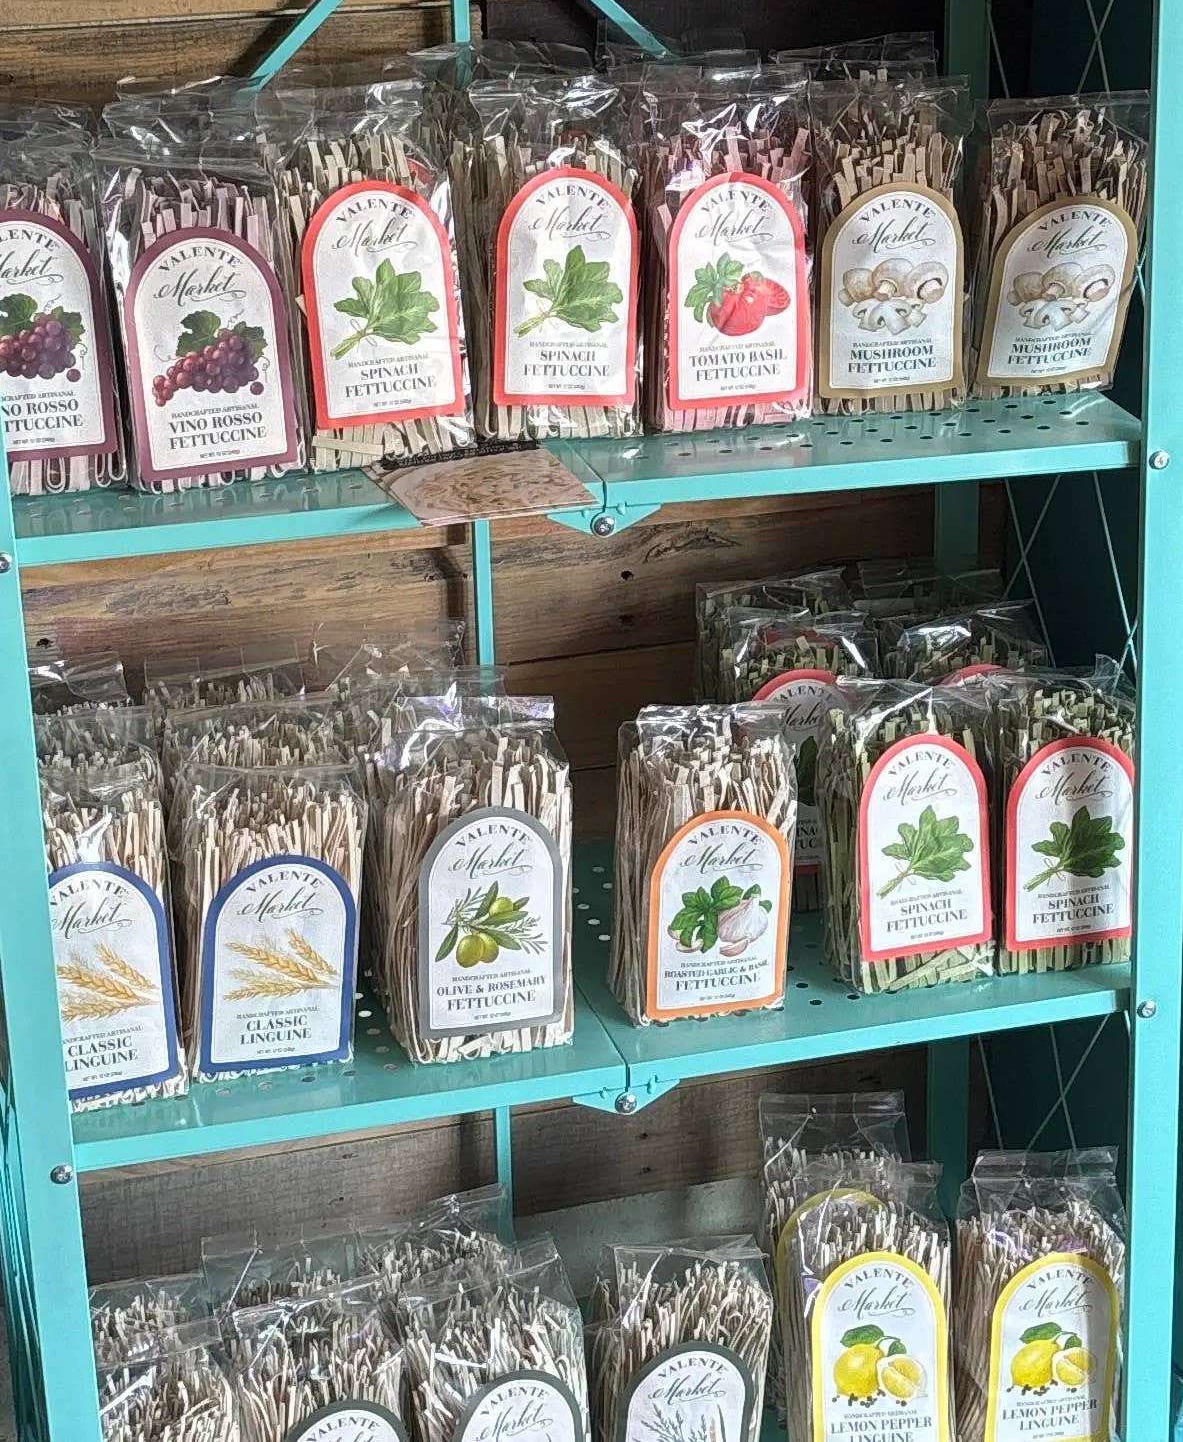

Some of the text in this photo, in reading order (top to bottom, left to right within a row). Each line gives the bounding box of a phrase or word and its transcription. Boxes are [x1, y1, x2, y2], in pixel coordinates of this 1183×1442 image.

[536, 185, 609, 208] VALENTE
[701, 190, 770, 213] VALENTE
[336, 198, 408, 224] VALENTE
[859, 198, 932, 222] VALENTE
[1038, 210, 1109, 231] VALENTE
[528, 205, 611, 241] Market
[695, 209, 774, 245] Market
[0, 229, 59, 251] LENTE
[331, 217, 418, 257] Market
[852, 216, 935, 253] Market
[1027, 225, 1107, 259] Market
[158, 246, 240, 272] VALENTE
[153, 266, 246, 307] Market
[540, 350, 596, 361] SPINACH
[850, 345, 934, 360] MUSHROOM
[1007, 347, 1091, 365] FETTUCCINE
[1011, 337, 1091, 354] MUSHROOM
[689, 348, 787, 367] TOMATO BASIL
[848, 357, 937, 373] FETTUCCINE
[360, 363, 418, 380] SPINACH
[523, 364, 609, 377] FETTUCCINE
[696, 364, 780, 381] FETTUCCINE
[345, 375, 436, 397] FETTUCCINE
[26, 399, 79, 415] ROSSO
[4, 414, 83, 433] TTUCCINE
[169, 411, 262, 434] VINO ROSSO
[170, 426, 267, 450] FETTUCCINE
[889, 751, 953, 776] VALENTE
[1042, 753, 1110, 775] VALENTE
[883, 768, 957, 806] Market
[1037, 772, 1112, 806] Market
[456, 825, 529, 847] VALENTE
[688, 825, 761, 845] VALENTE
[448, 842, 532, 879] Market
[679, 841, 763, 874] Market
[246, 871, 322, 893] VALENTE
[237, 887, 323, 923] Market
[901, 899, 952, 916] SPINACH
[1048, 894, 1100, 909] SPINACH
[51, 897, 132, 939] Market
[887, 909, 968, 933] FETTUCCINE
[1032, 903, 1114, 924] FETTUCCINE
[437, 975, 546, 996] OLIVE & ROSEMARY
[676, 972, 758, 991] FETTUCCINE
[447, 989, 536, 1011] FETTUCCINE
[246, 1015, 308, 1031] CLASSIC
[68, 1036, 133, 1057] CLASSIC
[240, 1028, 312, 1045] LINGUINE
[65, 1049, 138, 1072] LINGUINE
[845, 1268, 913, 1289] VALENTE
[1027, 1270, 1093, 1290] VALENTE
[838, 1285, 915, 1320] Market
[1019, 1285, 1093, 1318] Market
[658, 1357, 727, 1378] VALENTE
[648, 1373, 726, 1406] Market
[481, 1387, 548, 1415] VALENTE
[1003, 1399, 1097, 1420] LEMON PEPPER
[306, 1417, 377, 1442] VALENTE
[475, 1400, 553, 1442] Market
[831, 1417, 932, 1434] LEMON PEPPER
[1020, 1415, 1080, 1431] LINGUINE
